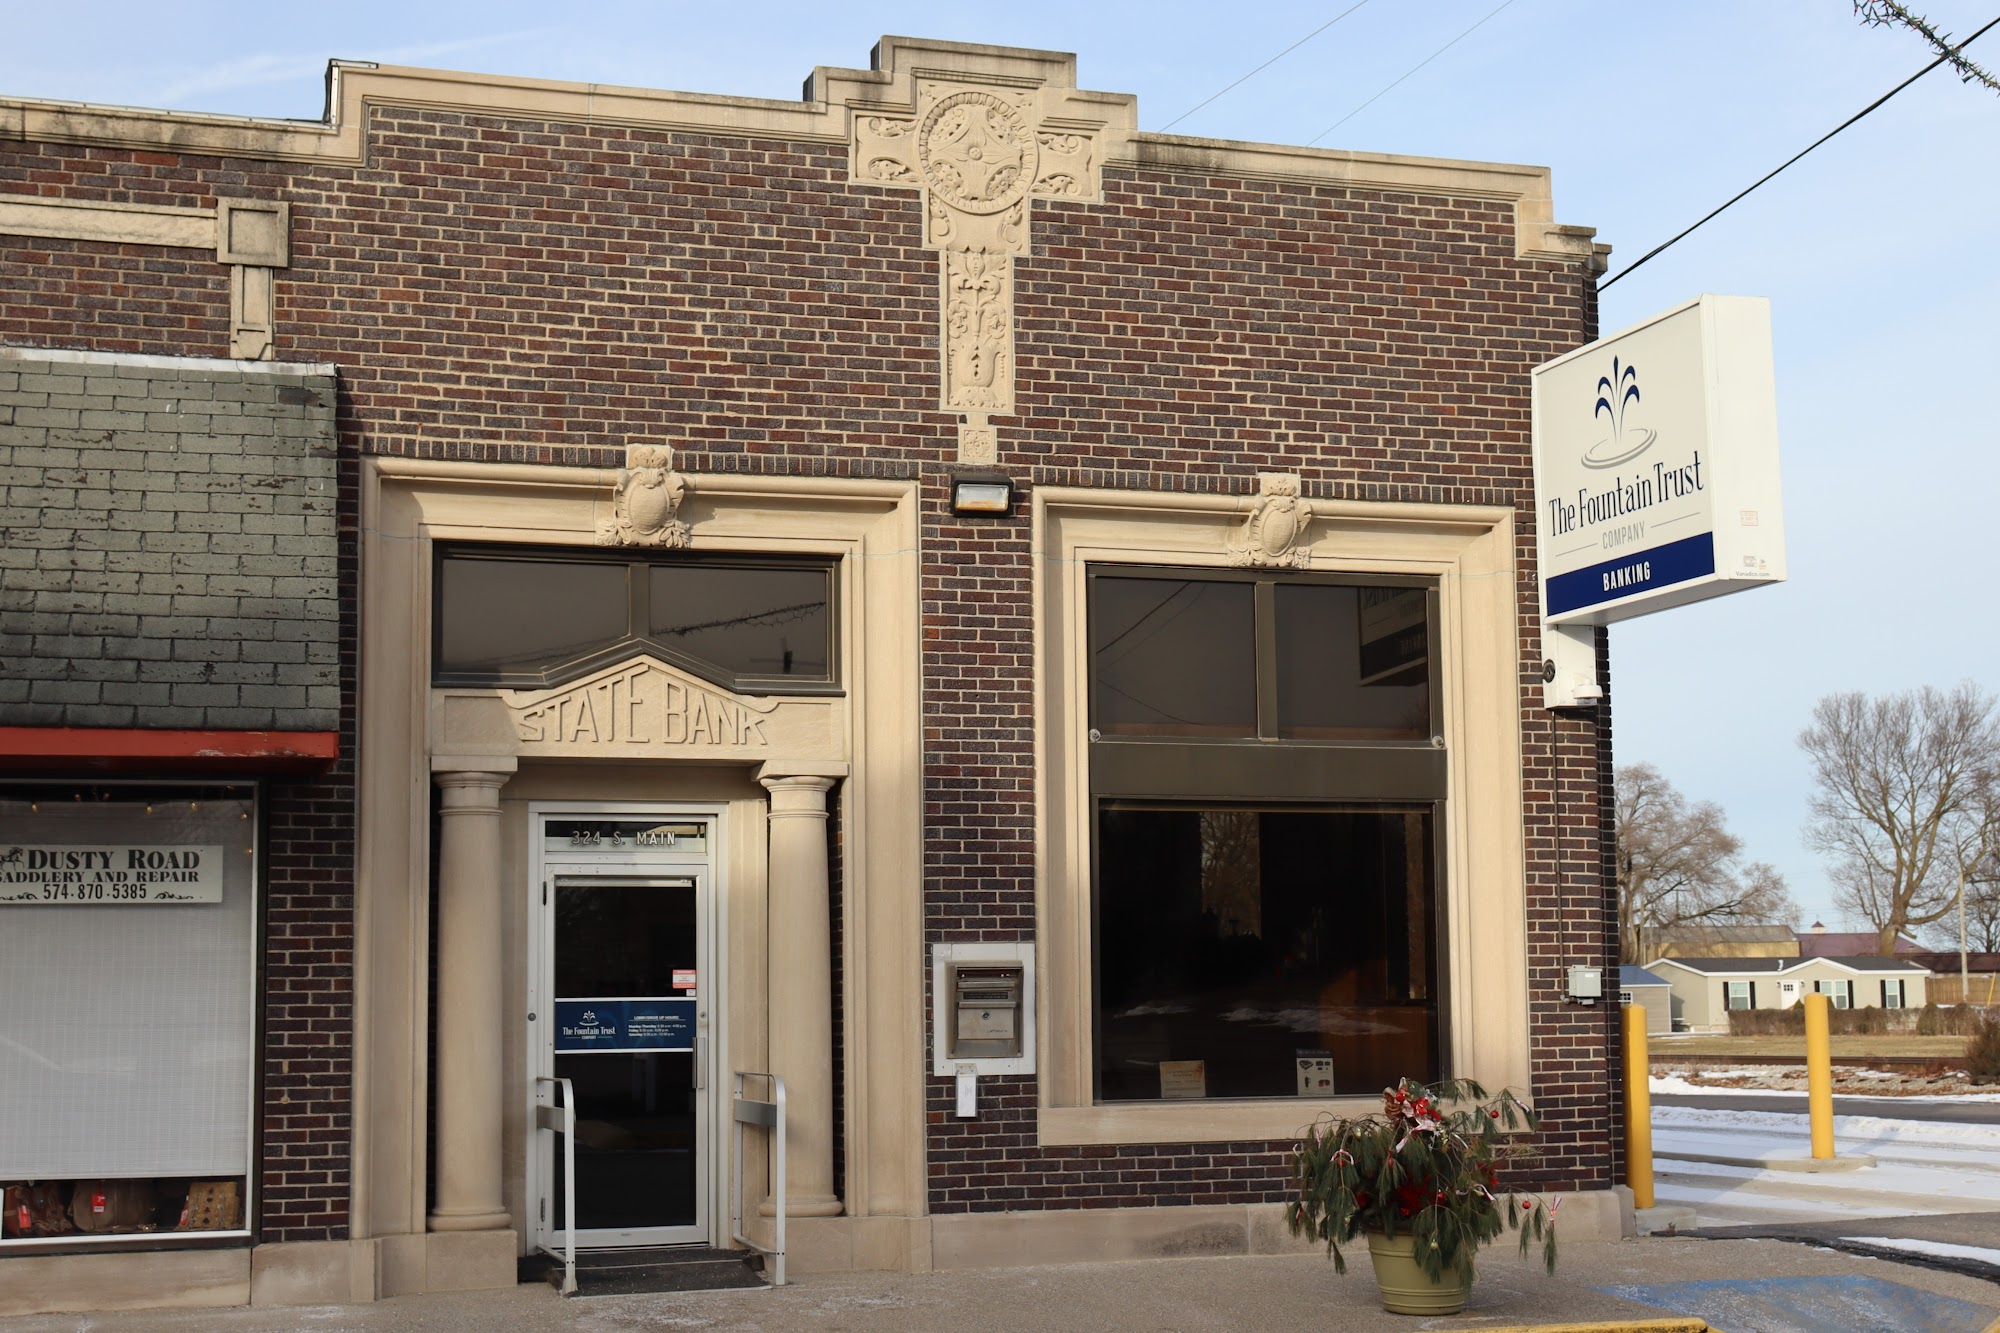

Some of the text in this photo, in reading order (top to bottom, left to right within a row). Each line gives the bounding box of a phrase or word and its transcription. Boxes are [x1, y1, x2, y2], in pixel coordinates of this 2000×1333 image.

[1549, 450, 1704, 537] The Fountain Trust
[1602, 520, 1646, 550] COMPANY
[1603, 560, 1651, 592] BANKING
[519, 664, 768, 746] STATE BANK
[572, 830, 676, 845] 324 S. MAIN
[27, 849, 200, 870] DUSTY ROAD
[0, 870, 200, 884] ADDLERY AND REPAIR
[562, 1026, 616, 1035] The Fountain Trust
